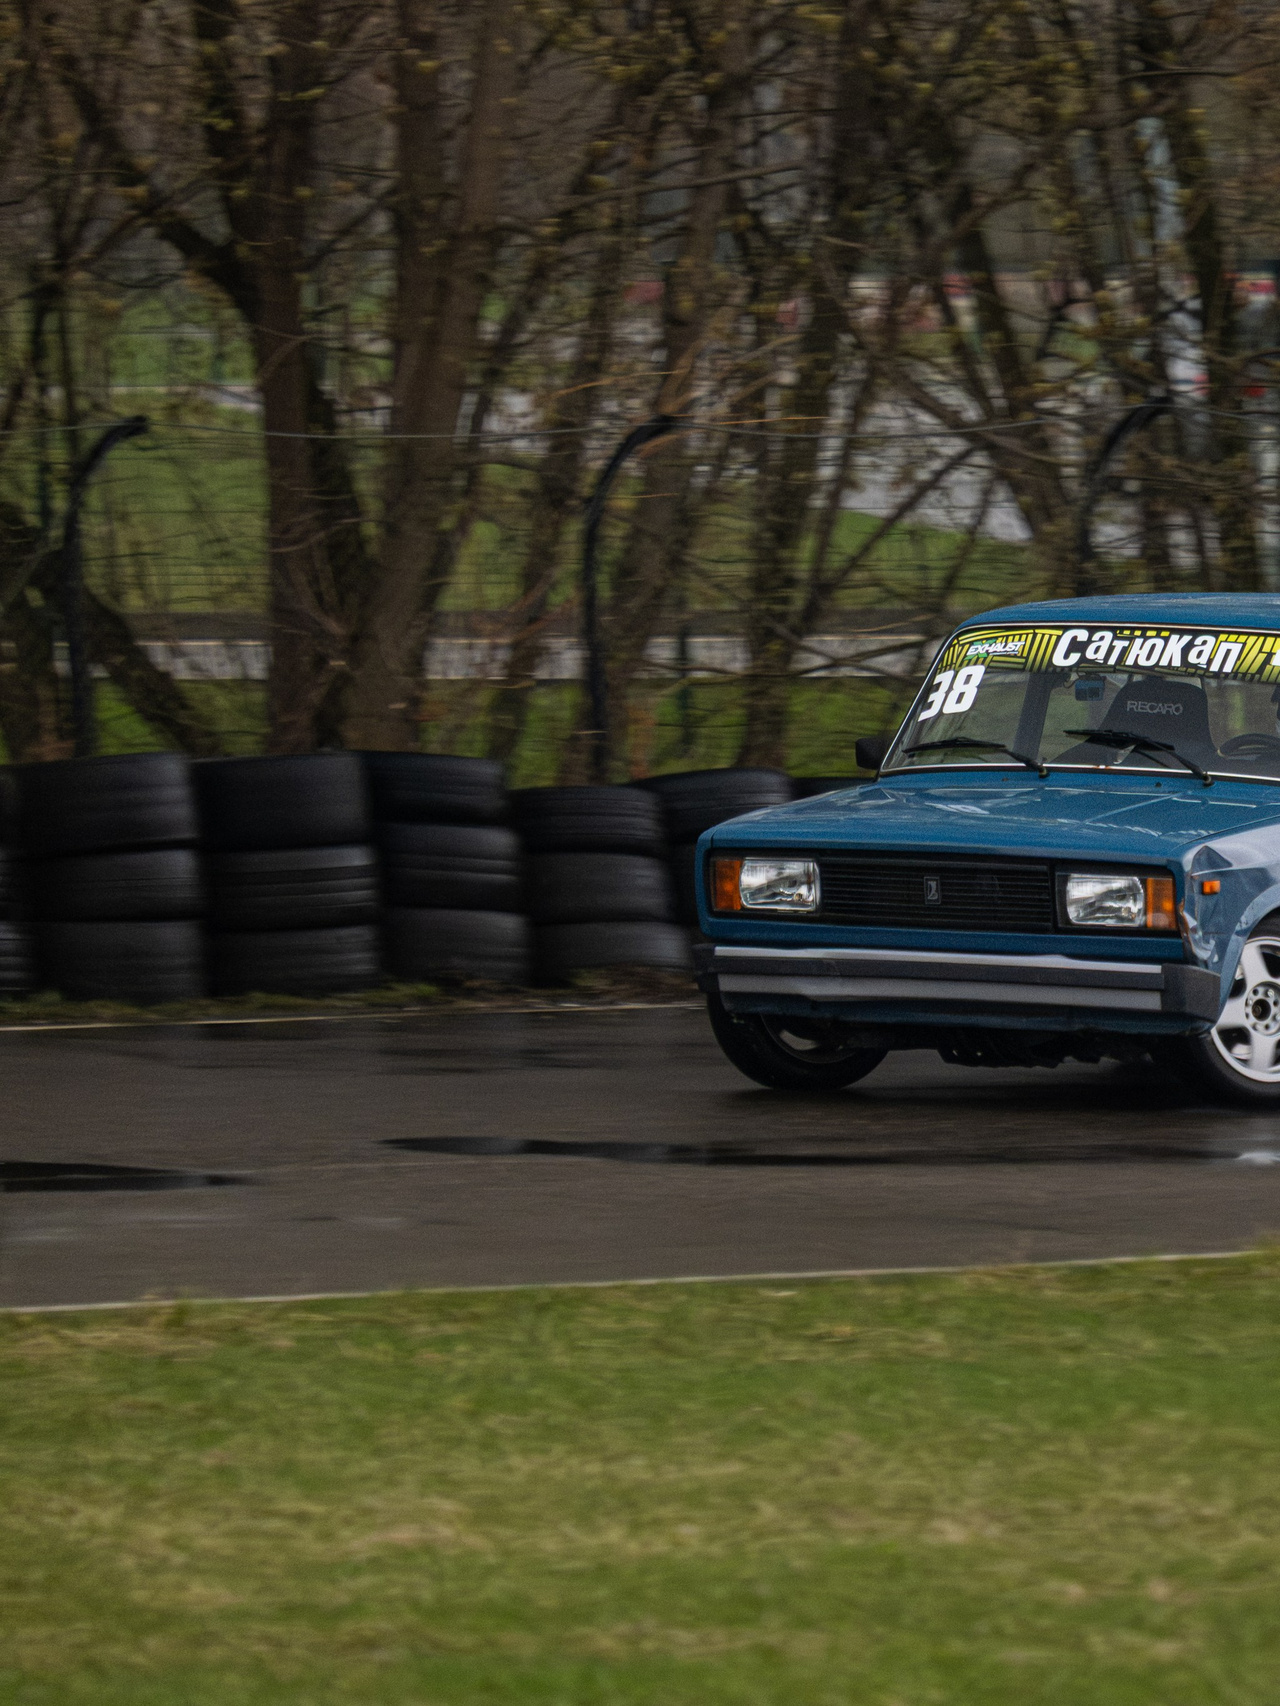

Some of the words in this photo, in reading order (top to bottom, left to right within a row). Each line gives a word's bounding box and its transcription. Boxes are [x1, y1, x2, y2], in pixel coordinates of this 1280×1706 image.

[966, 641, 1025, 656] EXHAUST
[918, 664, 986, 722] 38
[1127, 700, 1184, 716] RECARO
